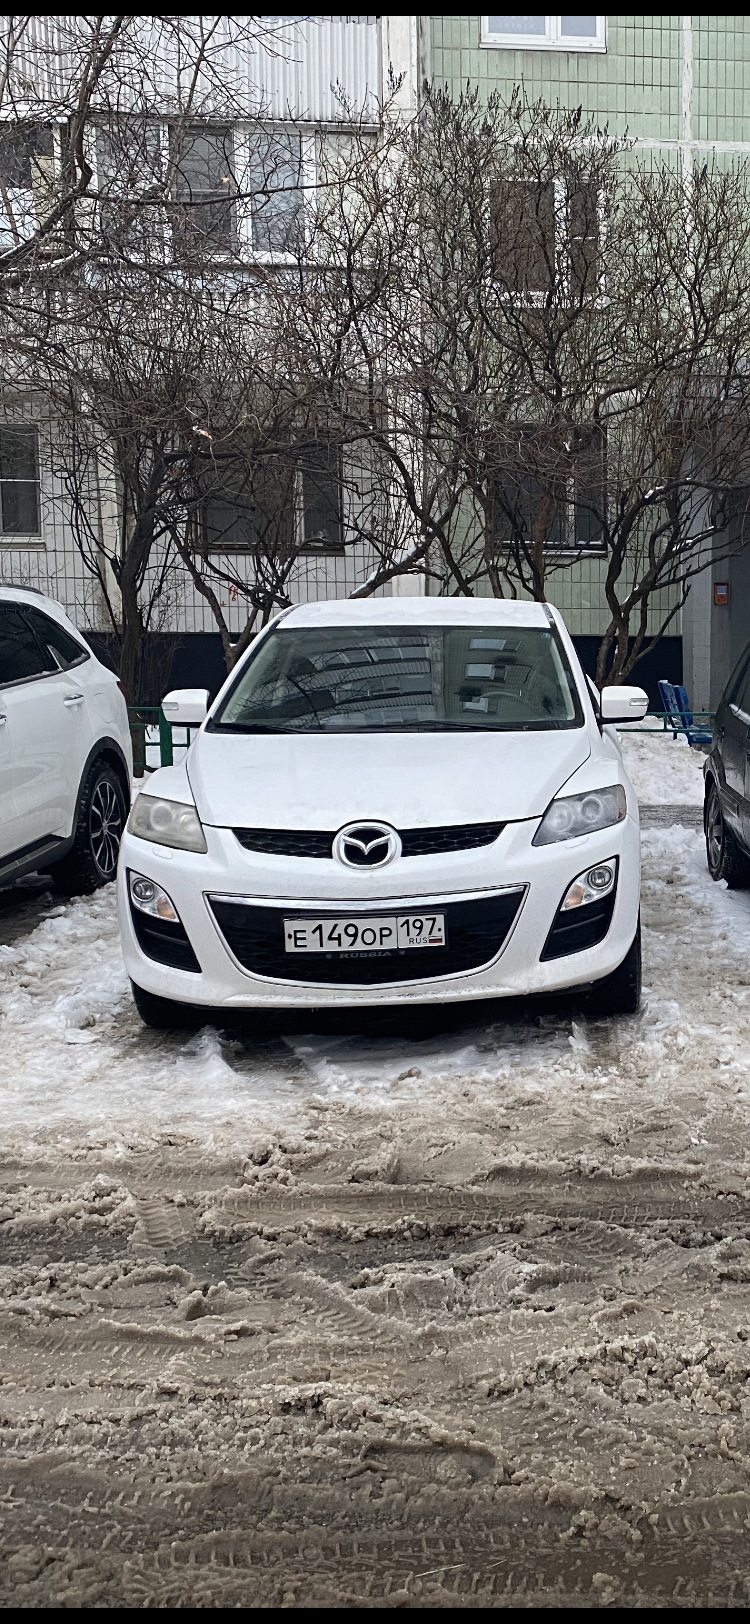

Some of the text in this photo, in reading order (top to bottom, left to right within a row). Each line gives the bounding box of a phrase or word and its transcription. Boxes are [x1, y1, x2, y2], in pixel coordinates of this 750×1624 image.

[400, 917, 437, 937] 197
[408, 937, 428, 945] RUS
[338, 951, 393, 959] RUSSIA
